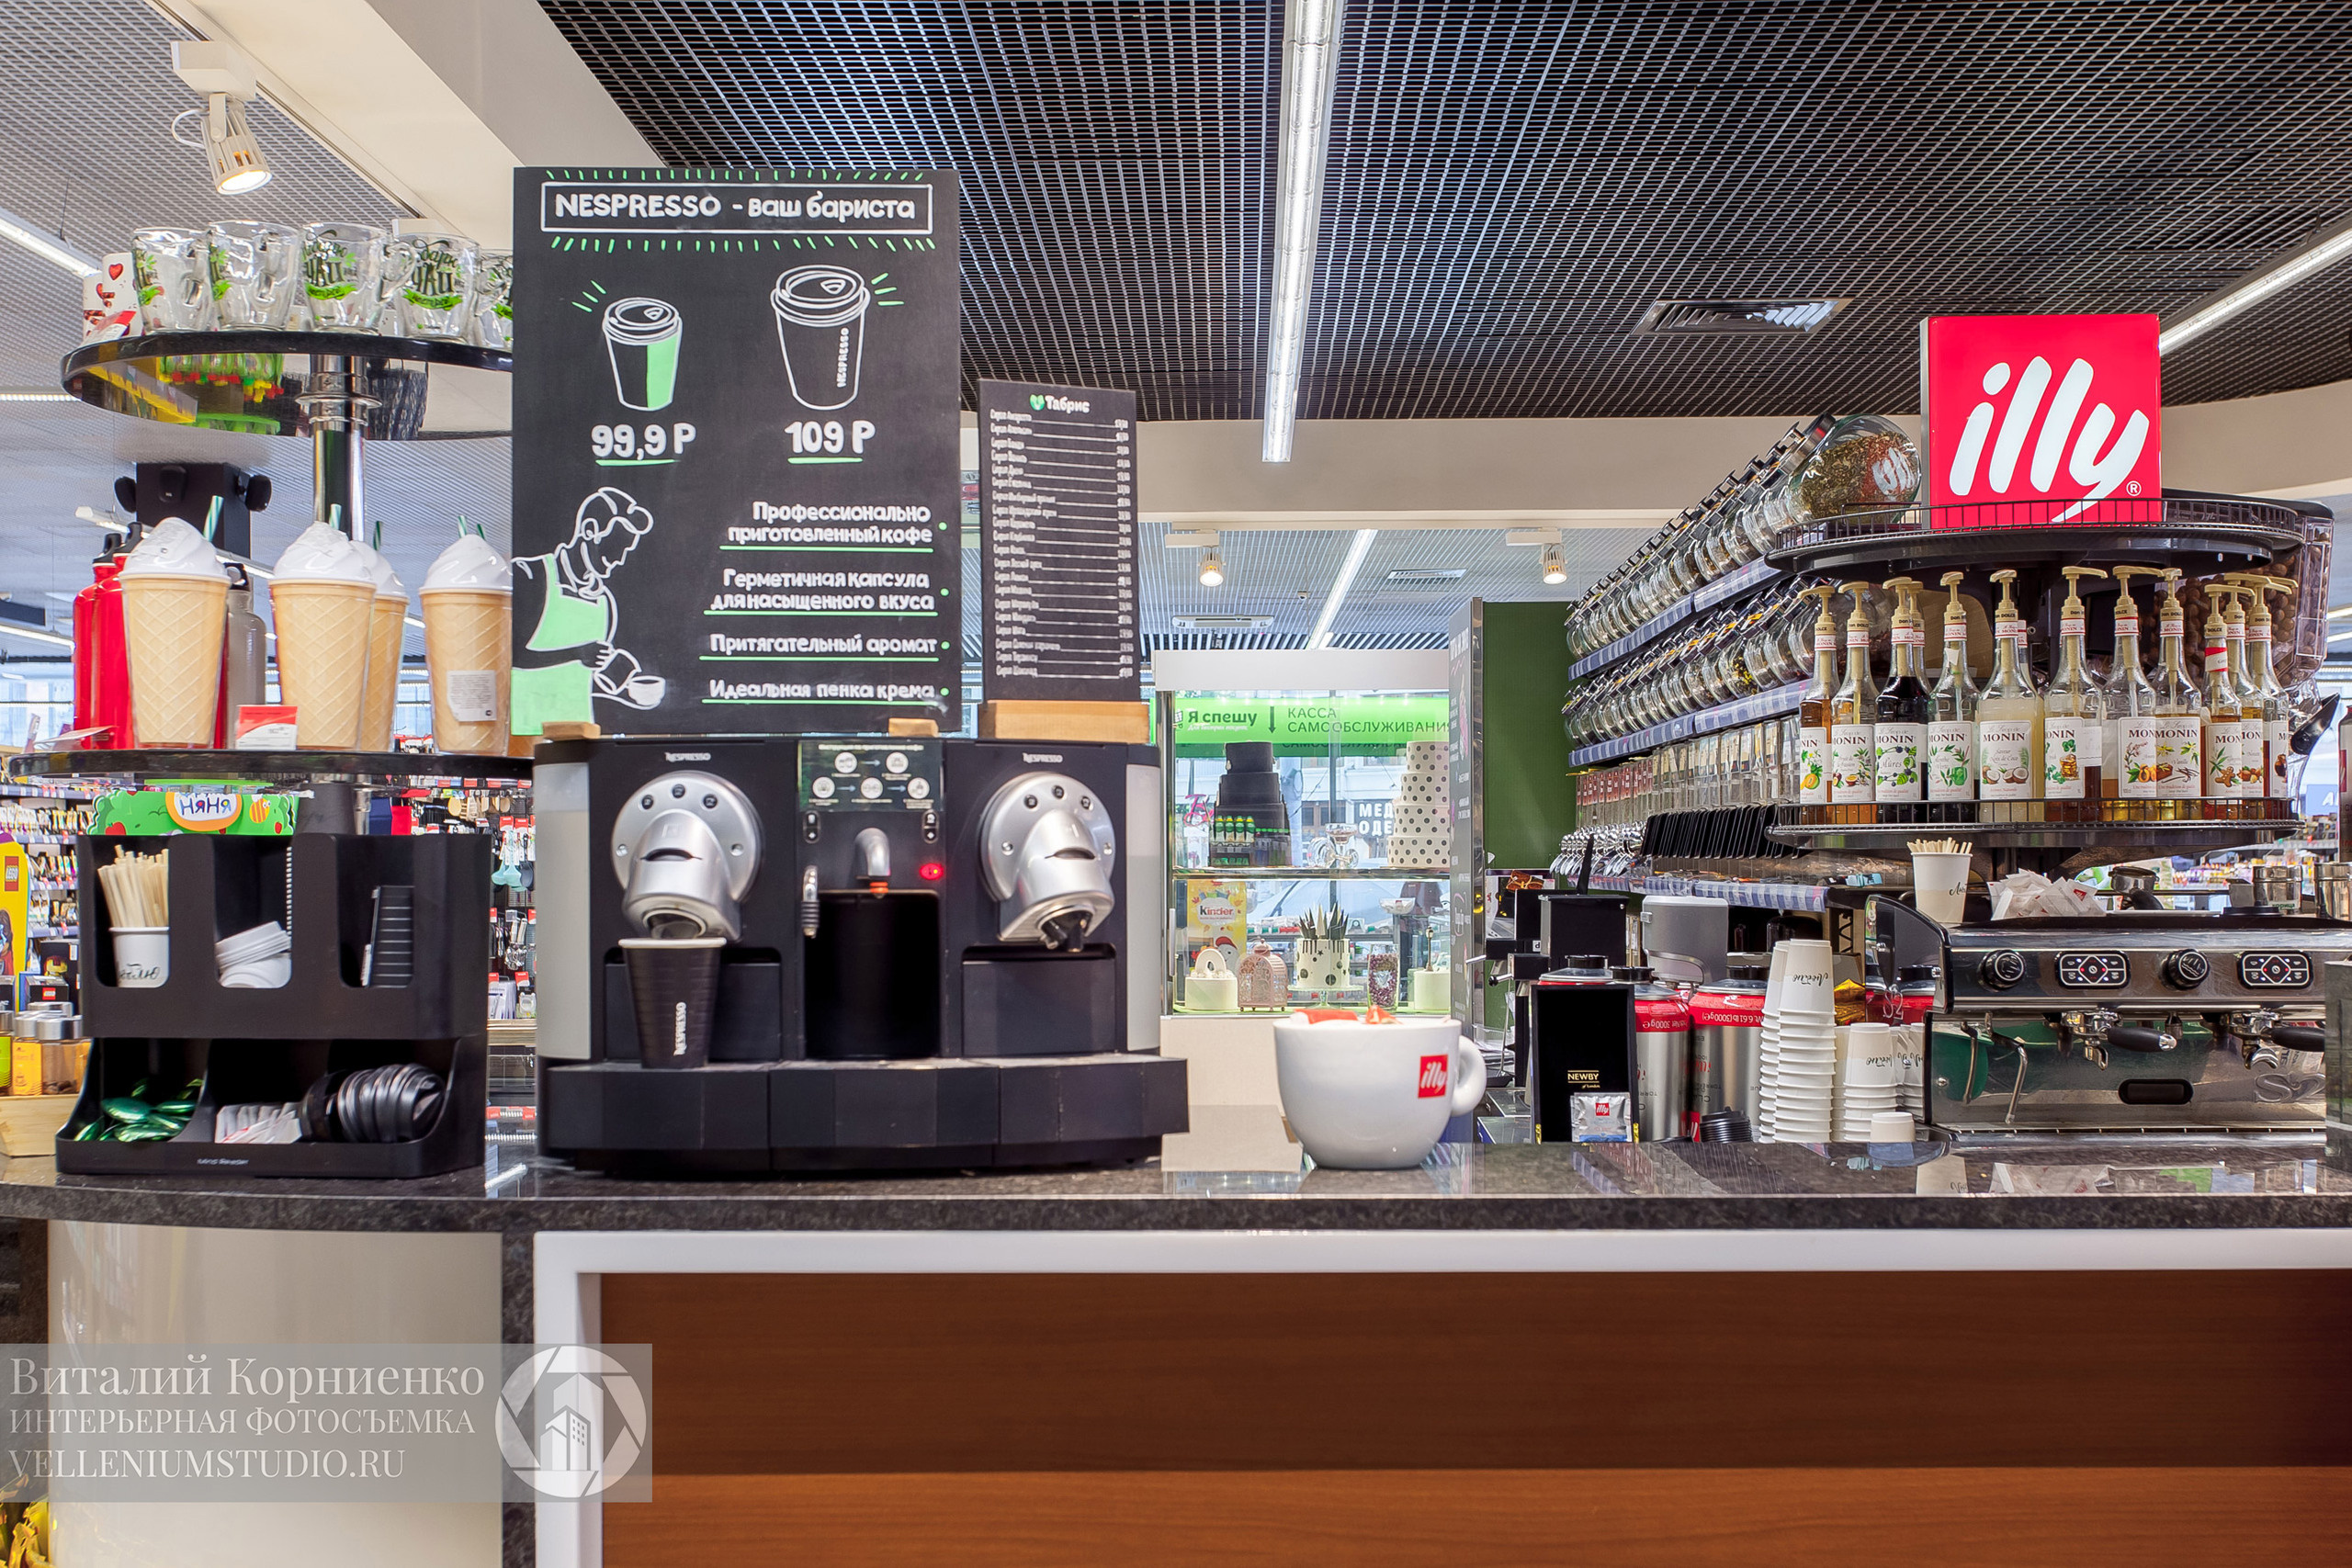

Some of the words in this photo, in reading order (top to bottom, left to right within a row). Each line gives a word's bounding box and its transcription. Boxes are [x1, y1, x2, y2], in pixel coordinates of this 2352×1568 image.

[555, 194, 721, 218] NESPRESSO
[748, 197, 801, 218] ваш
[807, 190, 915, 223] бариста
[836, 327, 850, 388] NESPRESSO
[1045, 395, 1091, 413] Табрис
[591, 423, 668, 460] 99,9
[785, 421, 843, 453] 109
[1950, 355, 2150, 523] illy
[752, 501, 932, 525] Профессионально
[728, 525, 880, 545] приготовленный
[881, 525, 933, 546] кофе
[723, 569, 846, 591] Герметичная
[847, 570, 930, 590] капсула
[711, 593, 747, 612] для
[747, 592, 875, 611] насыщенного
[879, 593, 934, 611] вкуса
[710, 633, 862, 653] Притягательный
[866, 637, 938, 654] аромат
[709, 679, 811, 699] Идеальная
[817, 682, 875, 698] пенка
[877, 682, 935, 701] крема
[1188, 710, 1198, 723] Я
[1203, 712, 1258, 727] спешу
[1287, 707, 1337, 719] КАССА
[1287, 721, 1449, 733] САМООБСЛУЖИВАНИ
[1984, 732, 2026, 742] MONIN
[2045, 729, 2075, 739] ONIN
[2129, 729, 2155, 739] MON
[2155, 728, 2198, 739] MONIN
[1199, 905, 1234, 916] Kinder
[1420, 1061, 1447, 1094] illy
[1597, 1103, 1609, 1115] illy
